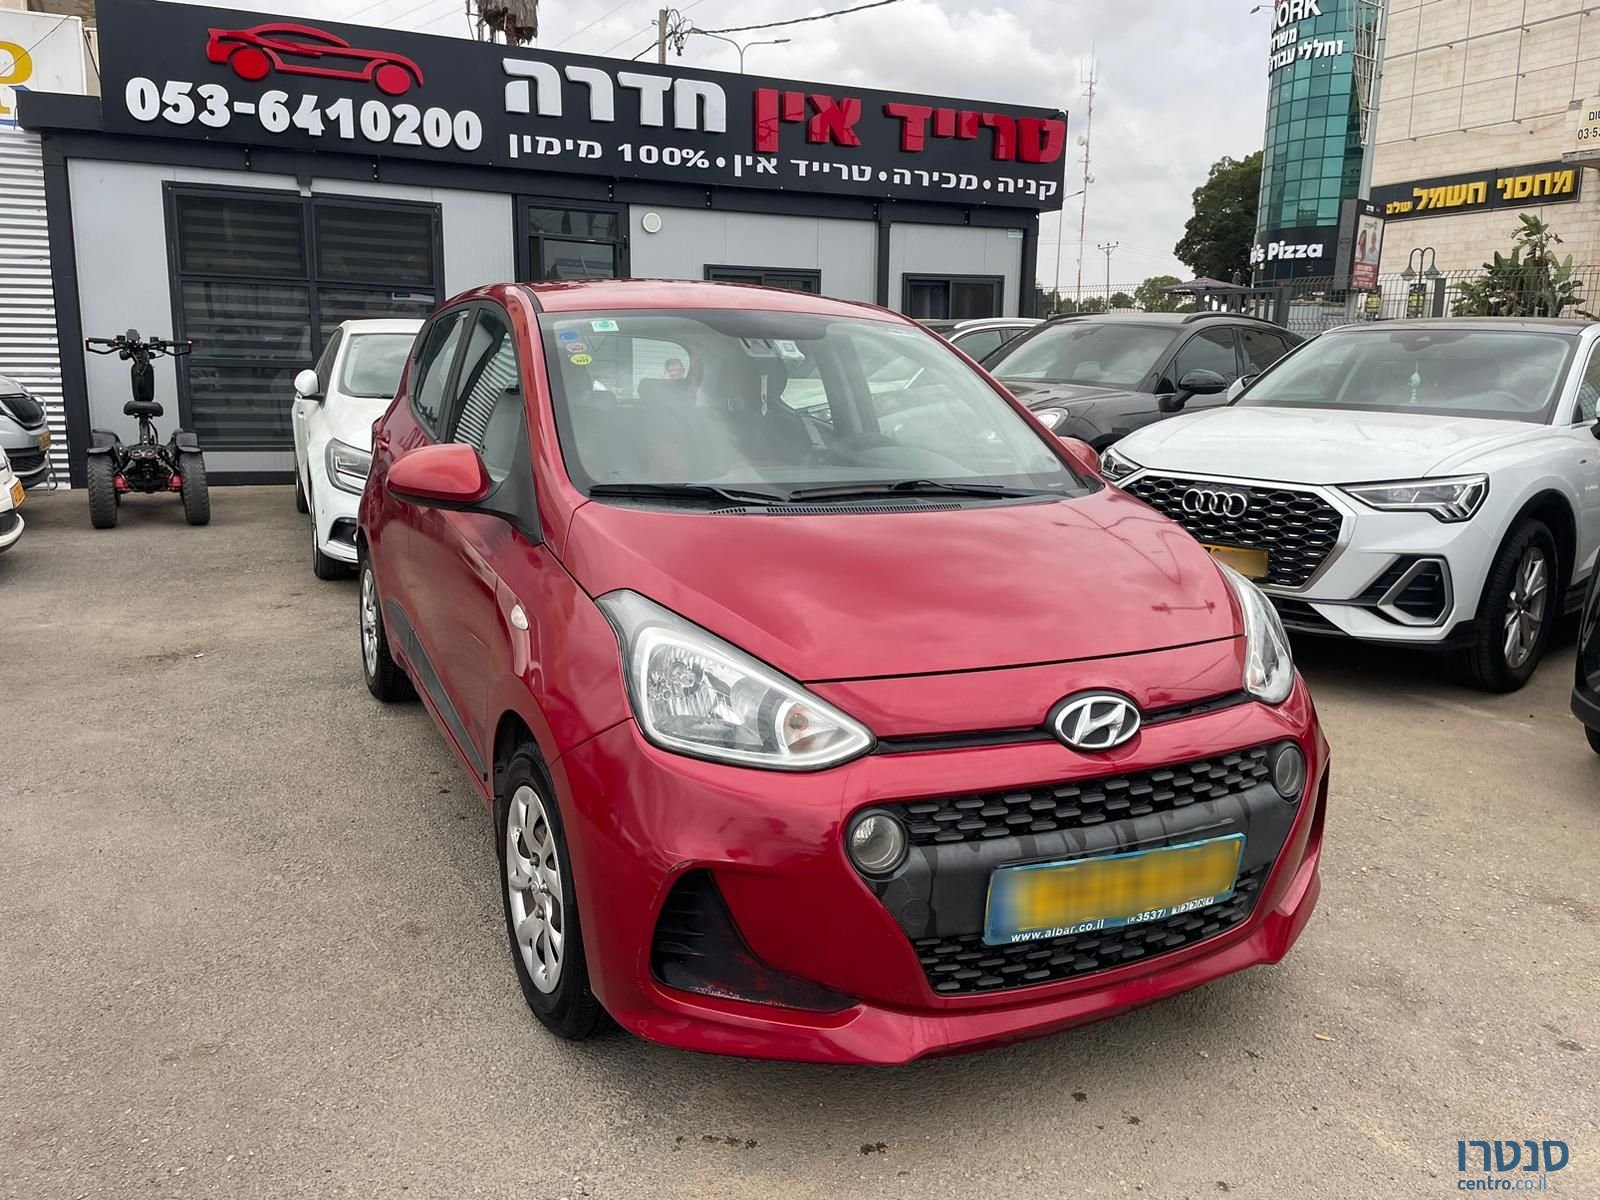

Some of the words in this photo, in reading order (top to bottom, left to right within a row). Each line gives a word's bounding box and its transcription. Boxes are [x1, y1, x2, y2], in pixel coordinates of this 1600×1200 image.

[1298, 39, 1343, 60] וחללי
[502, 57, 726, 133] חדרה
[125, 76, 482, 151] 053-6410200
[754, 88, 861, 153] אין
[883, 102, 1066, 163] טרייד
[509, 134, 602, 158] מימון
[617, 143, 709, 168] 100%
[734, 154, 778, 177] אין
[790, 159, 871, 181] טרייד
[893, 168, 978, 190] מכירה
[997, 176, 1057, 200] קניה
[1497, 169, 1575, 200] מחסני
[1412, 181, 1488, 211] חשמל
[1267, 240, 1323, 261] Pizza
[1011, 918, 1105, 942] www.albar.co.il
